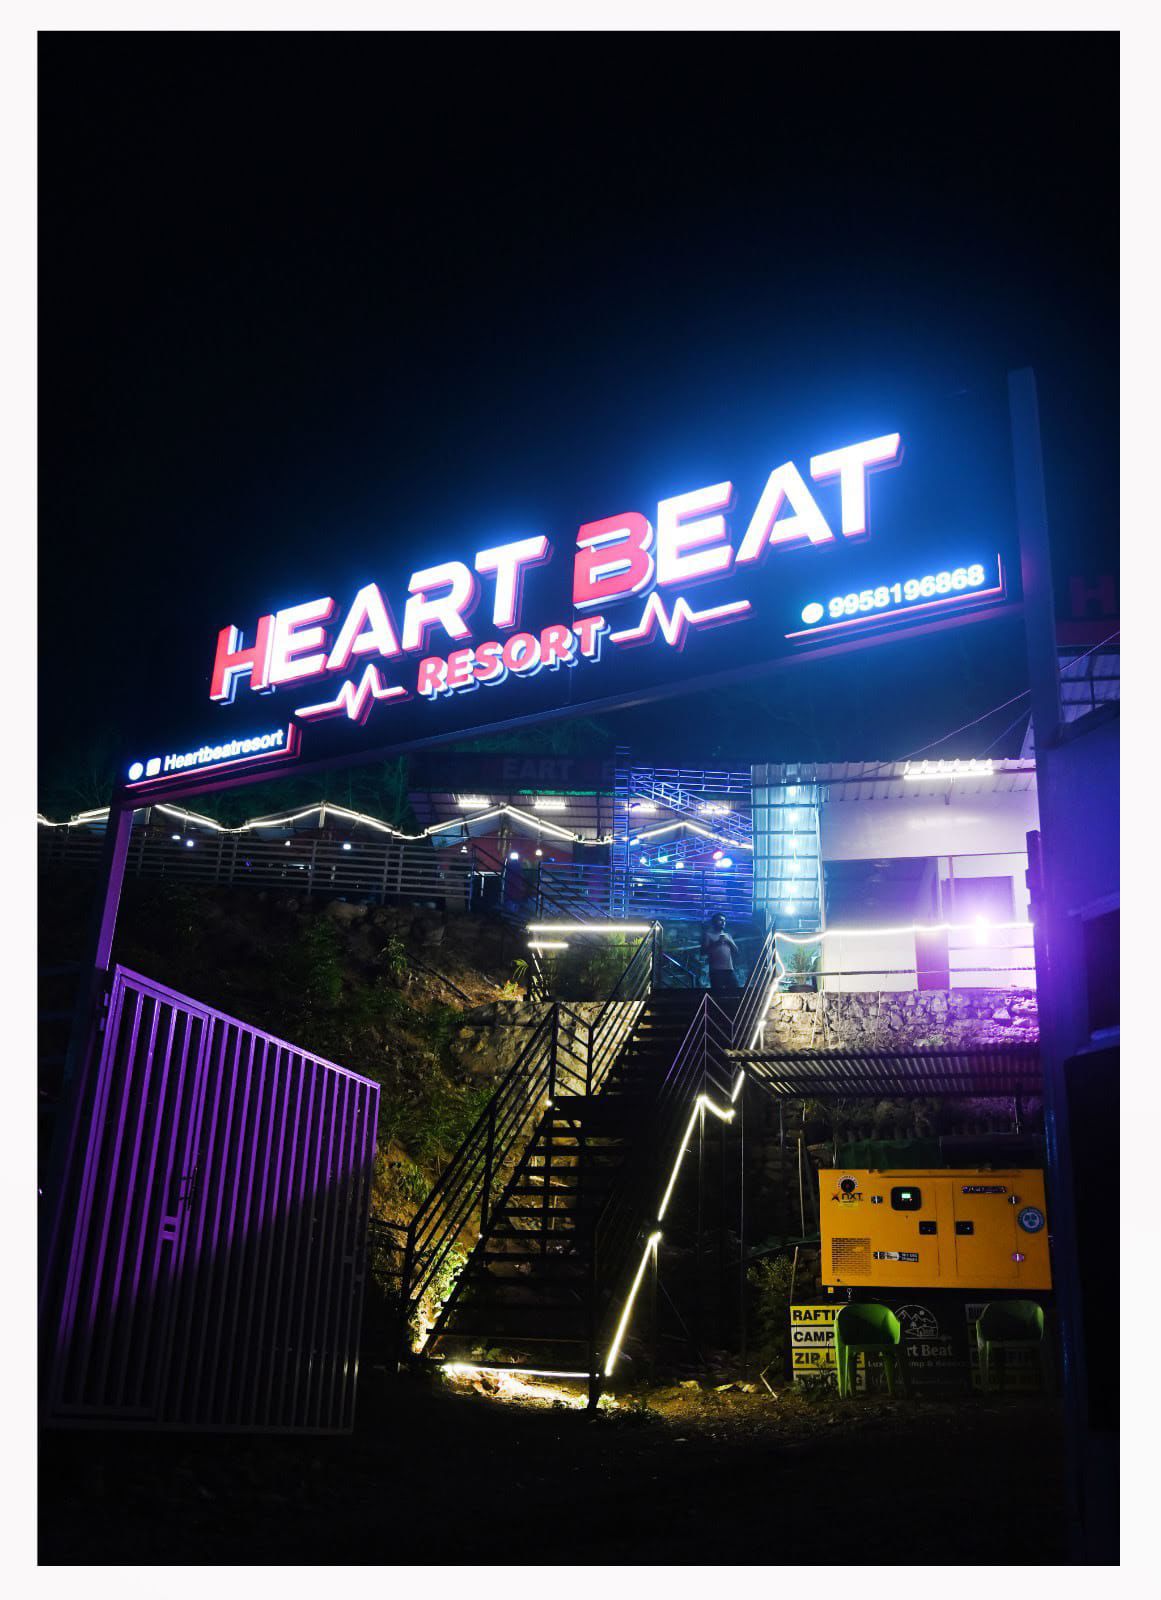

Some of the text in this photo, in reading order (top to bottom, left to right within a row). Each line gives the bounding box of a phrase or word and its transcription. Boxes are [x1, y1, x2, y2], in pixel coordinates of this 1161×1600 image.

[209, 432, 902, 702] HEART BEAT
[828, 564, 985, 618] 9958196868
[417, 615, 609, 701] RESORT
[163, 729, 285, 771] Heartbeatresort
[792, 1309, 838, 1321] RAFTI
[793, 1331, 835, 1343] CAMP
[921, 1343, 953, 1357] Beat
[794, 1352, 863, 1364] ZIP LE
